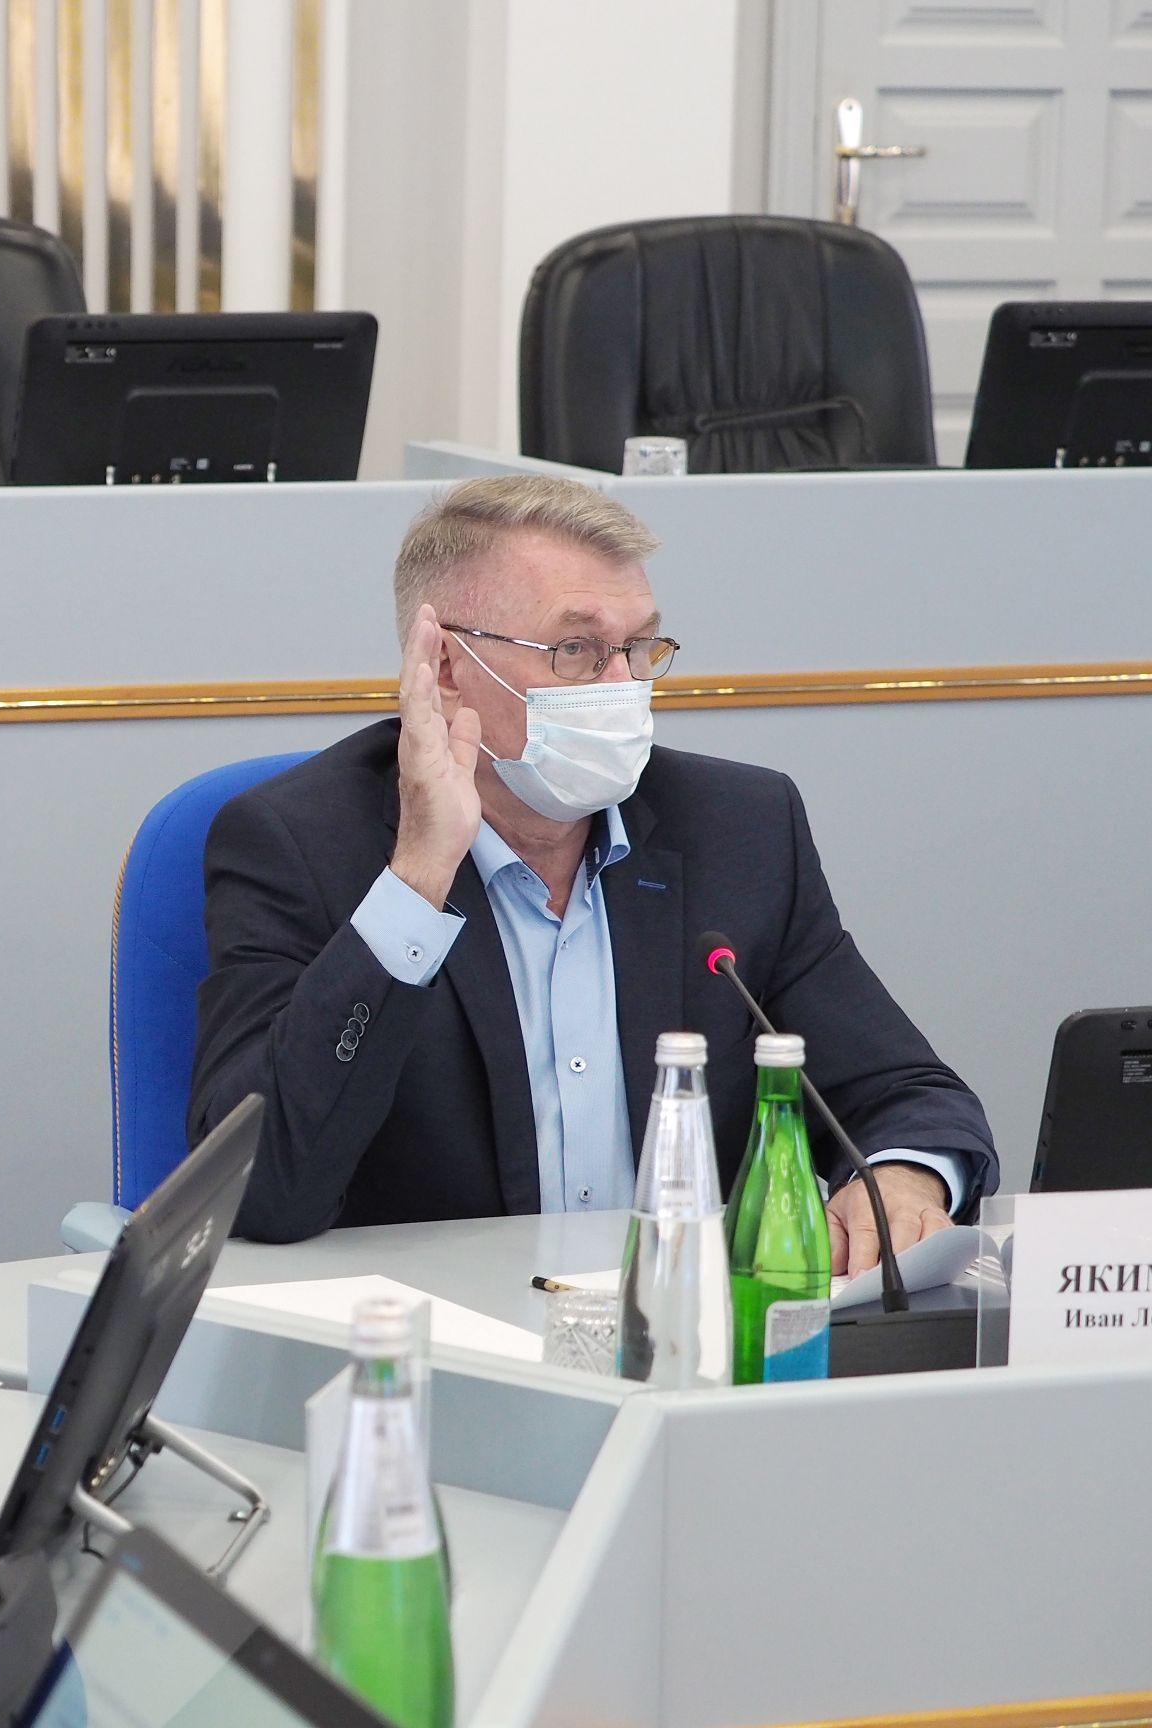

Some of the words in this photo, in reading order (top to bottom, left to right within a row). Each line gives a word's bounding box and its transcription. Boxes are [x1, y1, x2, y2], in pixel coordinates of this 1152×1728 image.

[1057, 1264, 1152, 1293] ЯКИ
[1065, 1308, 1123, 1328] Иван
[1131, 1307, 1152, 1328] Л
